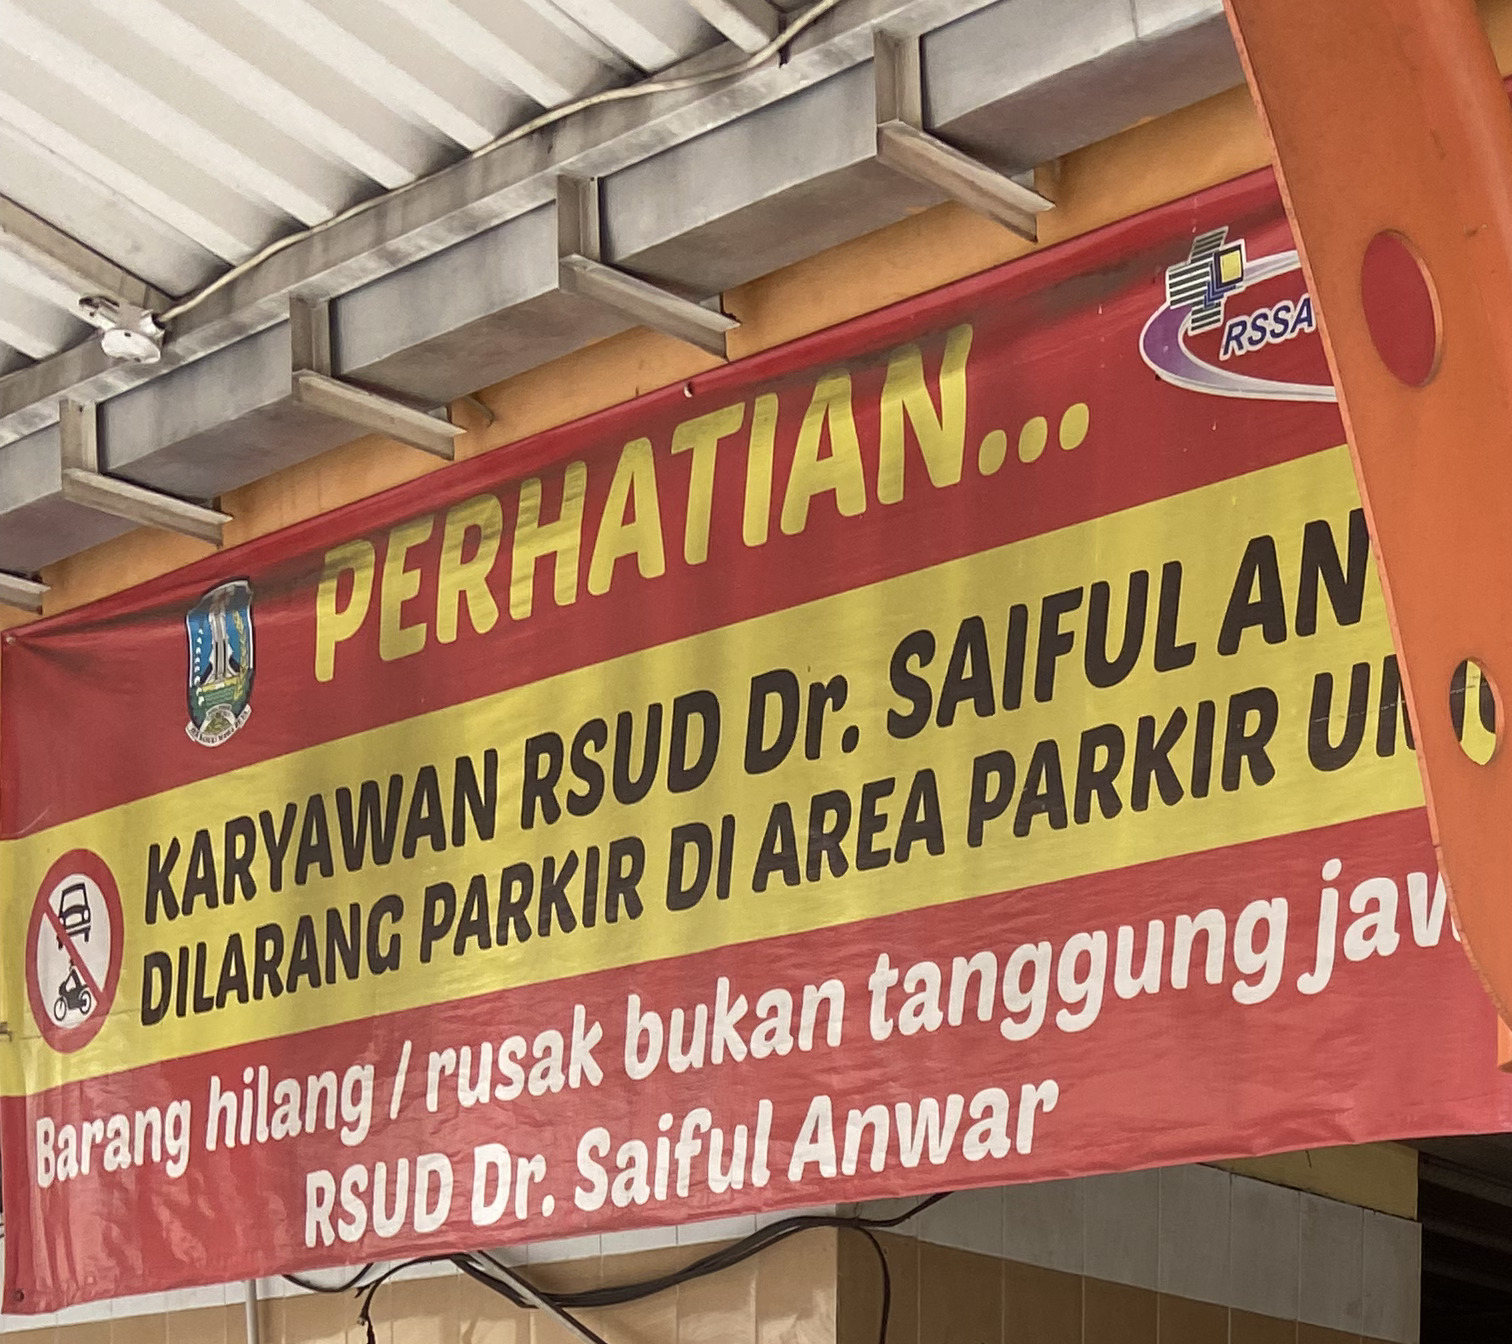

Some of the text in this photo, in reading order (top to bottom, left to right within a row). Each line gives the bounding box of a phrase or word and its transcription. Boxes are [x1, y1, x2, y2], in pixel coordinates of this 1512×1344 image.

[1222, 296, 1315, 358] RSSA
[141, 894, 404, 1026] DILARANG
[419, 836, 646, 964] PARKIR
[666, 814, 736, 911] DI
[751, 768, 945, 893] AREA
[967, 687, 1279, 848] PARKIR
[143, 748, 499, 925] KARYAWAN
[520, 689, 721, 830] RSUD
[744, 668, 860, 775] Dr.
[886, 560, 1197, 740] SAIFUL
[35, 1094, 191, 1189] Barang
[205, 1063, 375, 1151] hilang
[389, 1039, 413, 1121] /
[425, 1003, 604, 1113] rusak
[623, 975, 846, 1081] bukan
[867, 896, 1289, 1041] tanggung
[304, 1079, 1060, 1249] RSUD Dr. Saiful Anwar
